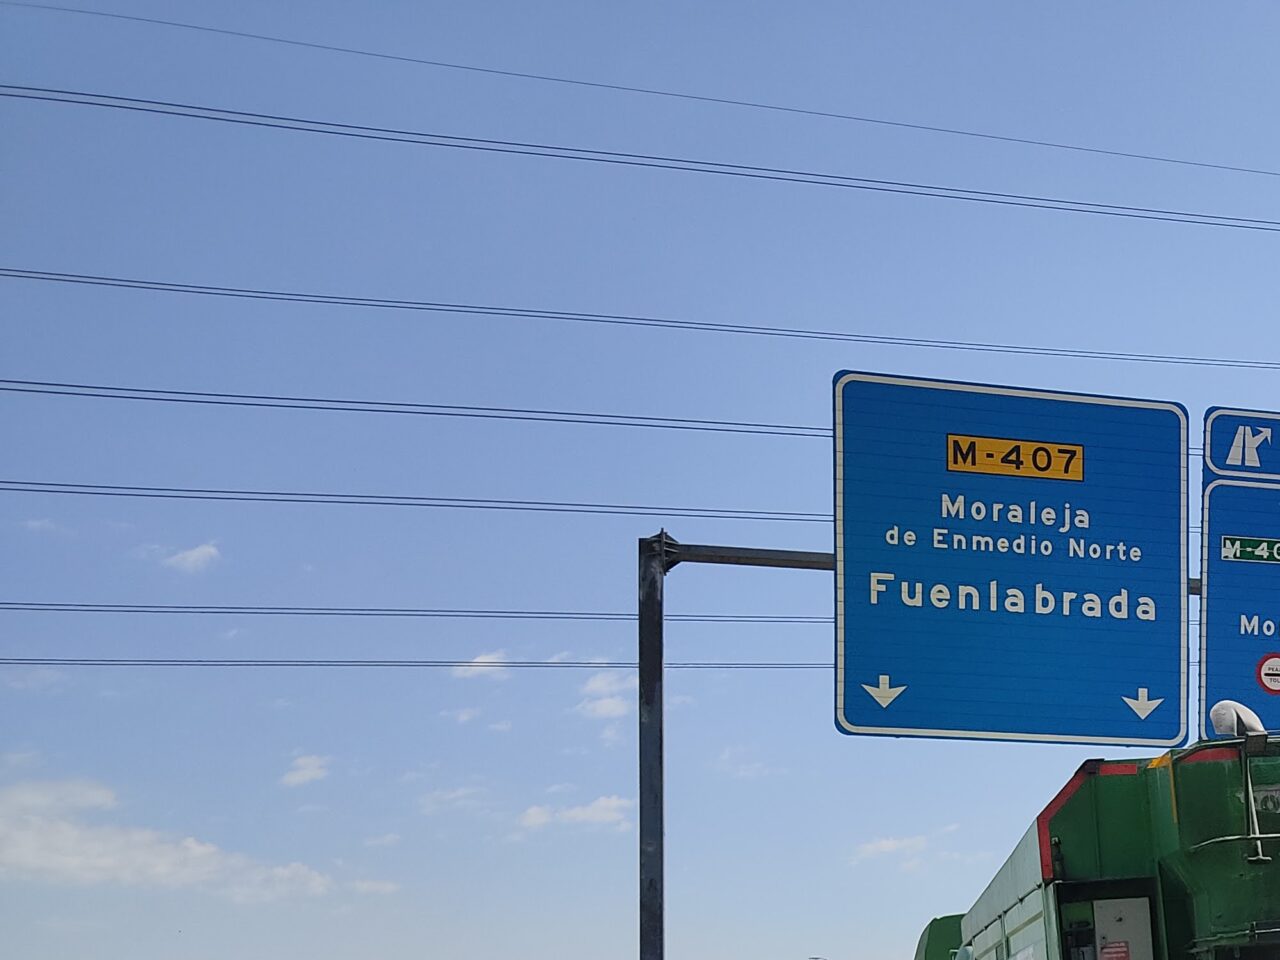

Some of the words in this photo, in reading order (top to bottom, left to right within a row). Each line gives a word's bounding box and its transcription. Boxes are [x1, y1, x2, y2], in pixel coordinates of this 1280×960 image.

[951, 440, 1078, 475] M-407
[941, 493, 1090, 532] Moraleja
[885, 525, 917, 546] de
[933, 528, 1053, 556] Enmedio
[1069, 537, 1142, 562] Norte
[870, 572, 1156, 621] Fuenlabrada
